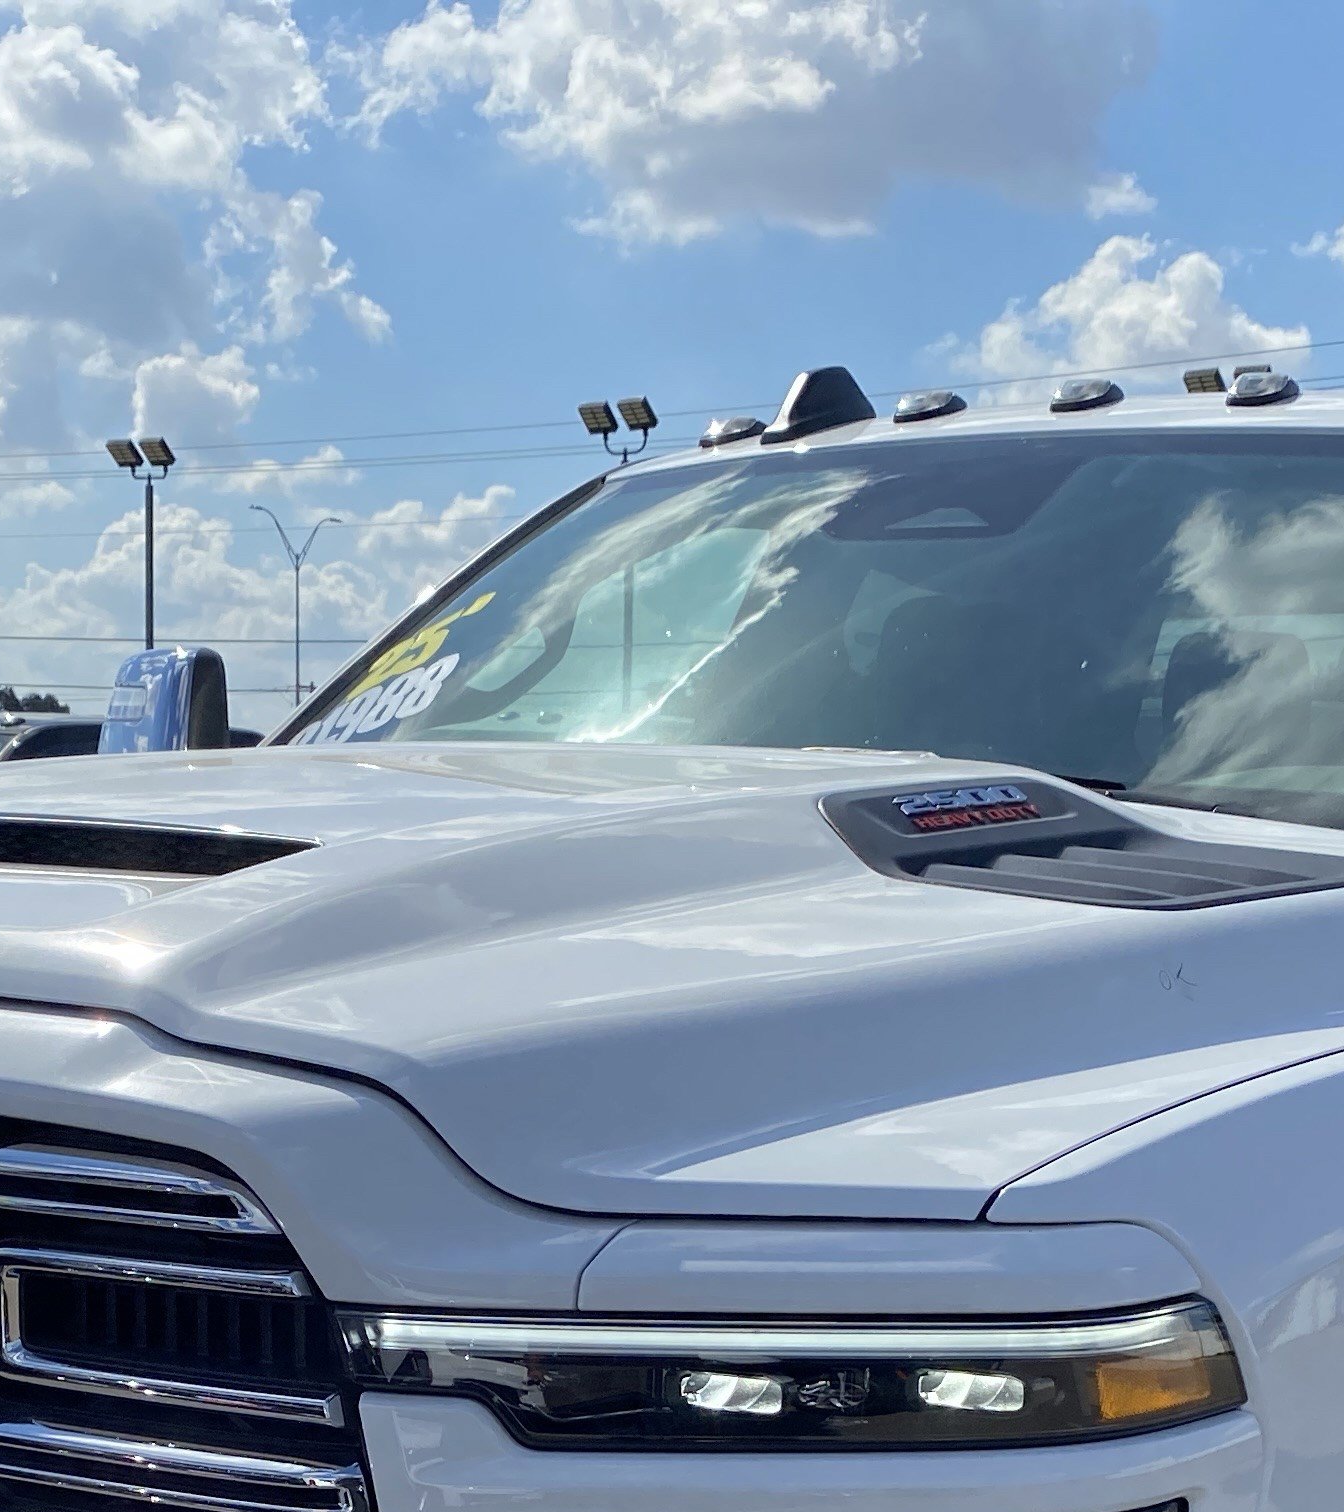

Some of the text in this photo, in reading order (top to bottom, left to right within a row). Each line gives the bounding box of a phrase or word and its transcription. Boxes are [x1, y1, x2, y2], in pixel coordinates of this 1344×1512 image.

[892, 785, 1028, 815] 2500
[912, 804, 1041, 831] HEAVY DUTY
